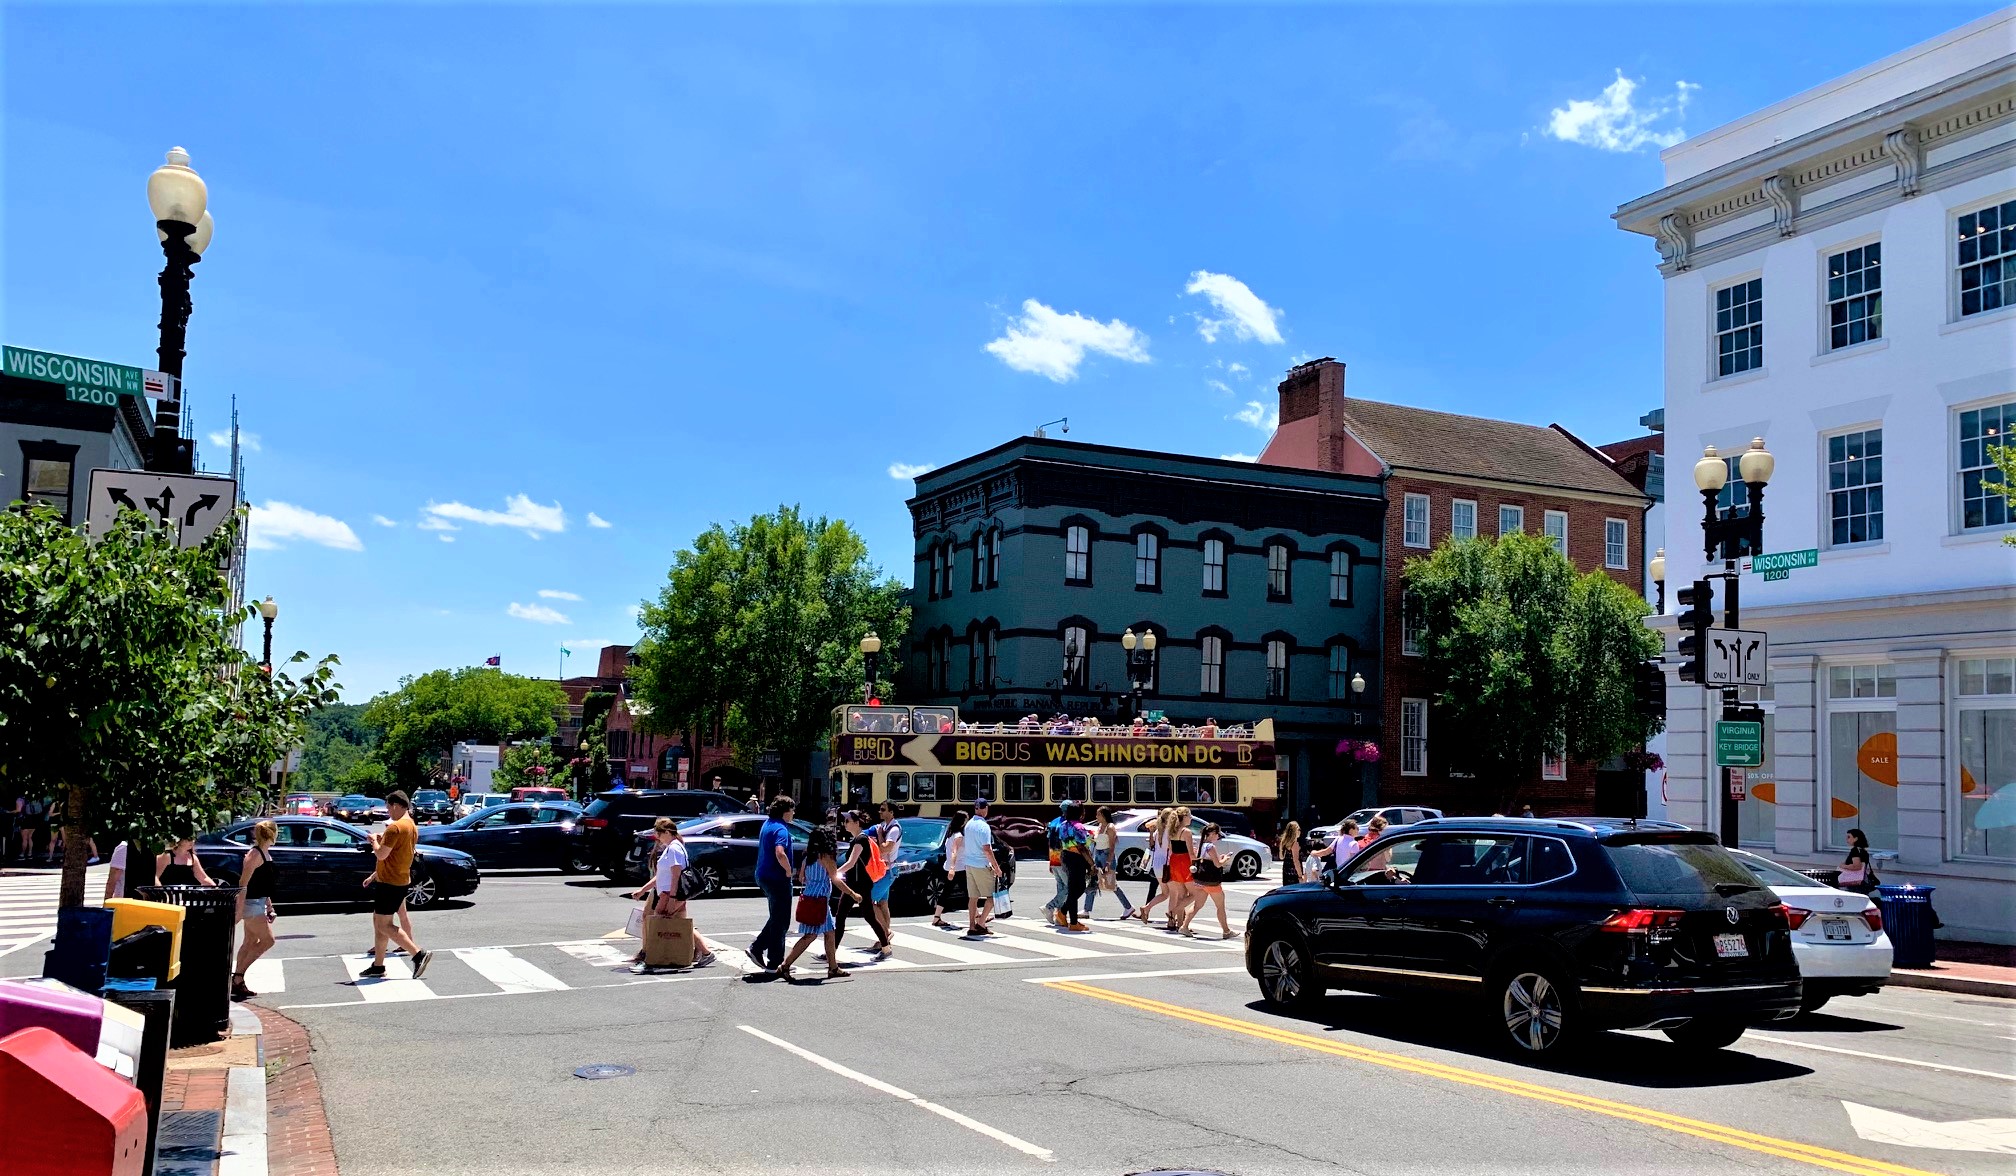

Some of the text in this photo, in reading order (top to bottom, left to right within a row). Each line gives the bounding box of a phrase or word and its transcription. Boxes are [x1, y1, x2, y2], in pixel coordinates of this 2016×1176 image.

[8, 350, 122, 389] WISCONSIN
[125, 370, 139, 381] AVE
[126, 380, 138, 391] NW
[67, 385, 118, 406] 1200
[1754, 550, 1807, 571] WISCONSIN
[1765, 569, 1789, 580] 1200
[1713, 671, 1728, 680] ONLY
[1747, 672, 1761, 681] ONLY
[1023, 698, 1063, 709] BANANA
[1721, 726, 1756, 735] VIRGINIA
[854, 737, 877, 749] BIG
[1719, 742, 1759, 751] KEY BRIDGE
[853, 749, 877, 760] BUS
[1046, 742, 1188, 764] WASHINGTON
[1195, 744, 1222, 764] DC
[1870, 756, 1889, 764] SALE
